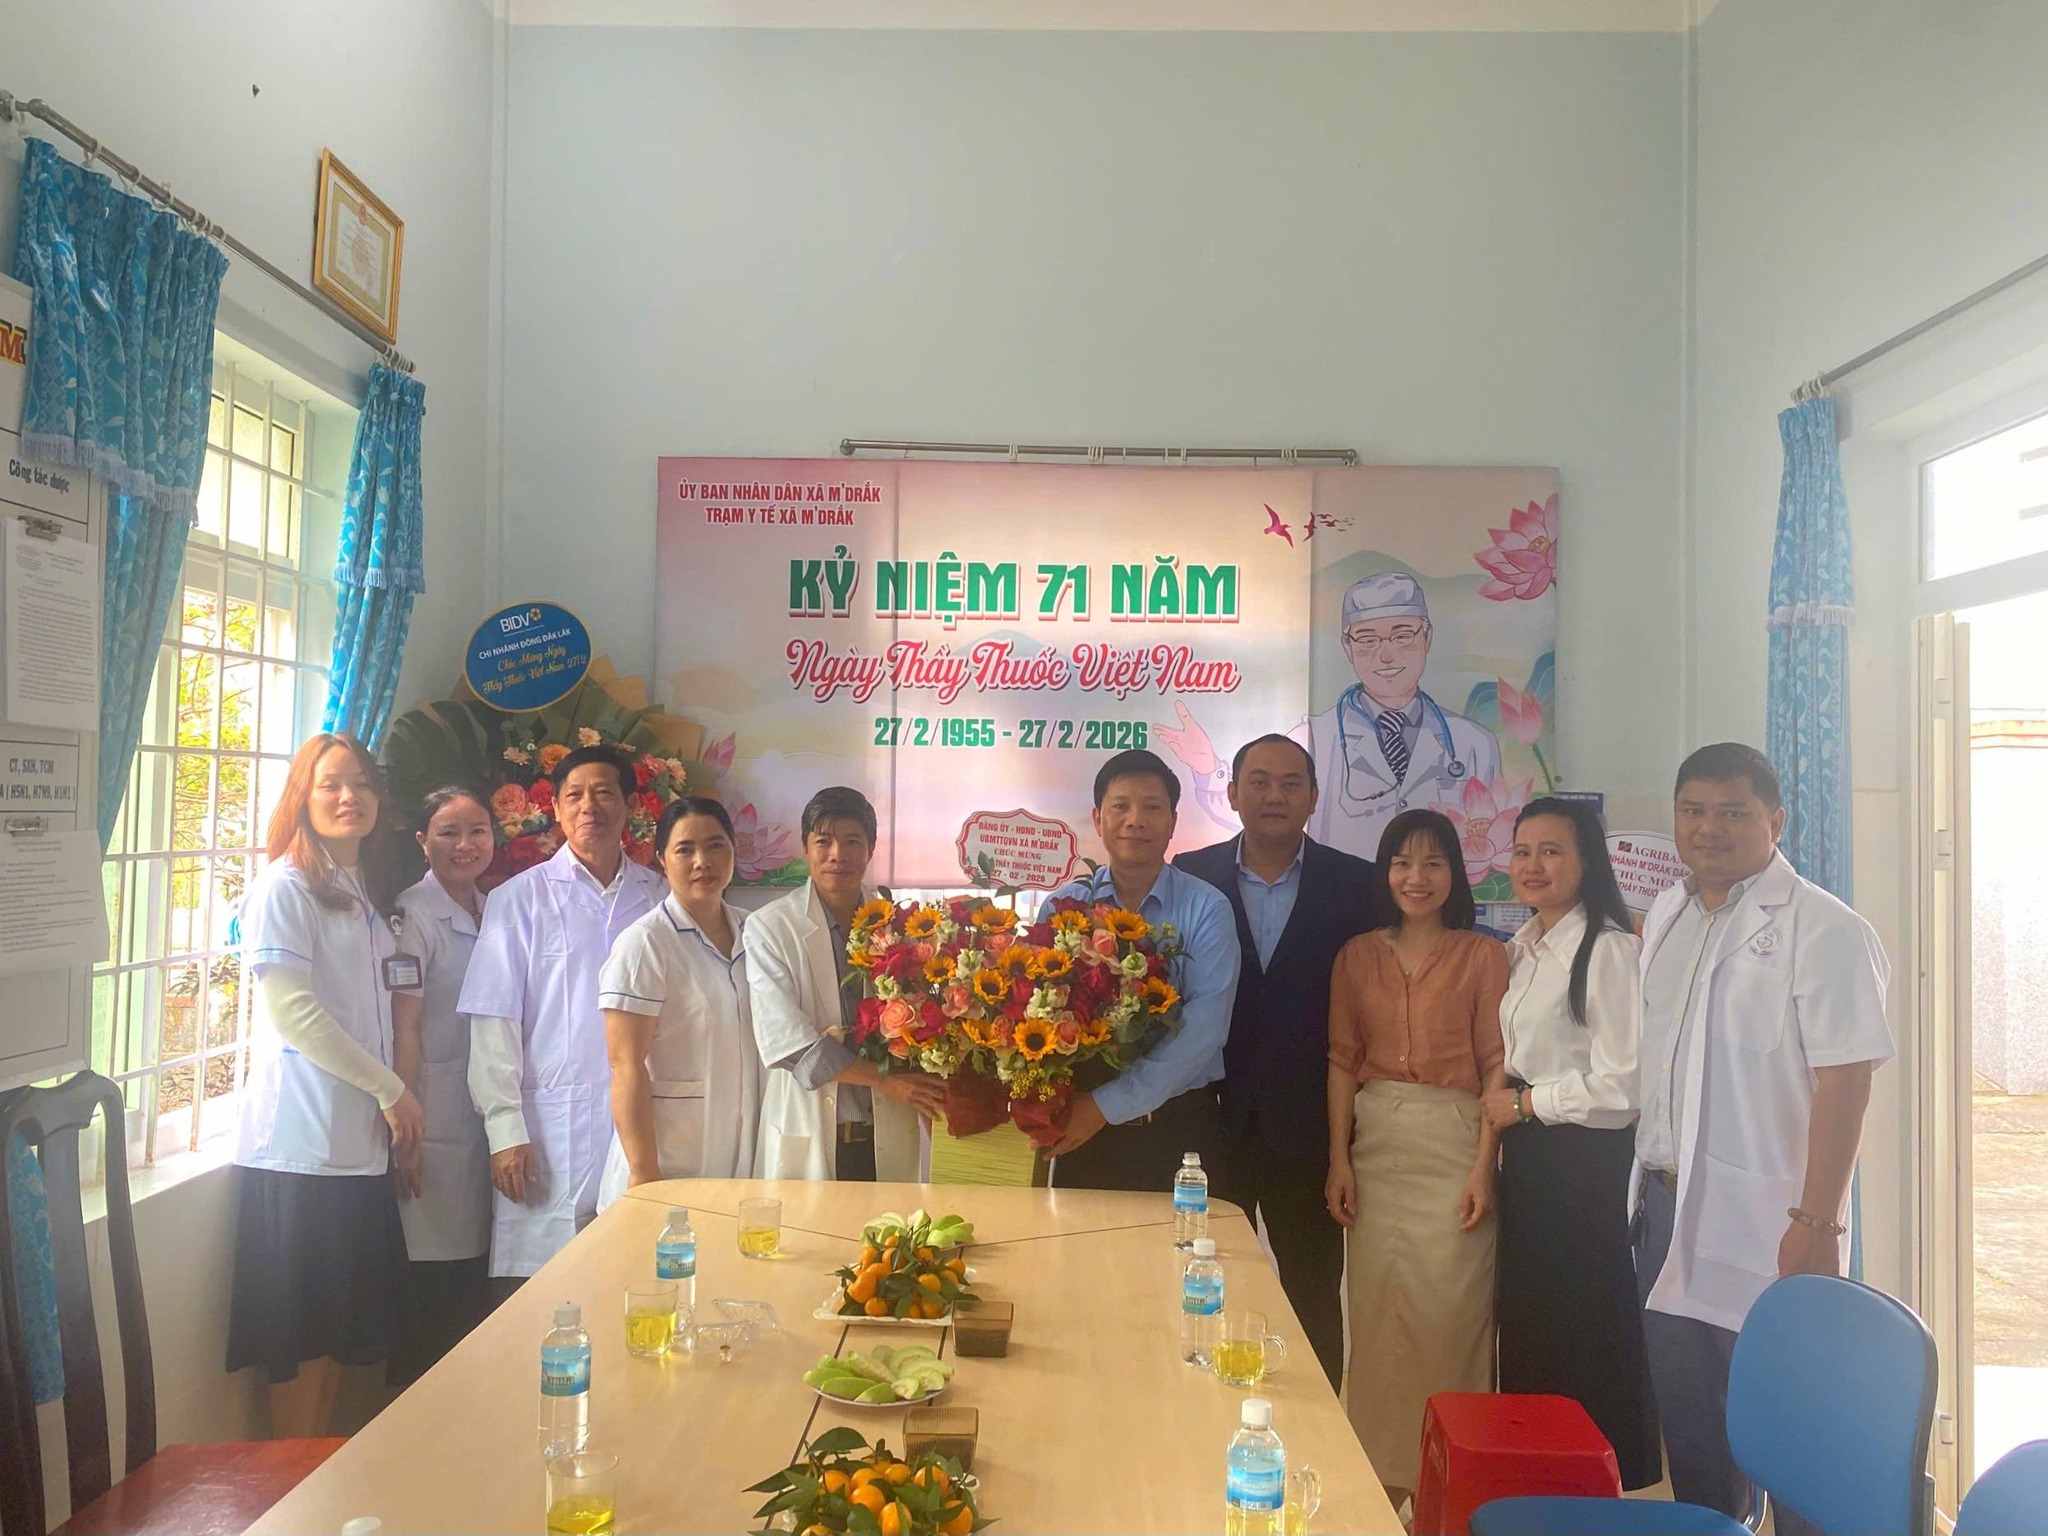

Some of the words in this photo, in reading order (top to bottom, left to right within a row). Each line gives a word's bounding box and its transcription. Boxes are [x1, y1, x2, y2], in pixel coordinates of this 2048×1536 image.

[10, 459, 32, 483] Công
[34, 467, 48, 487] tác
[679, 478, 697, 500] ỦY
[700, 484, 728, 500] BAN
[733, 482, 771, 501] NHÂN
[775, 482, 802, 502] DÂN
[806, 483, 825, 502] XÃ
[706, 508, 744, 526] TRẠM
[748, 508, 757, 524] Y
[760, 504, 776, 524] TẾ
[780, 506, 798, 525] XÃ
[789, 545, 857, 614] KỶ
[875, 551, 1018, 626] NIỆM
[1037, 564, 1088, 616] 71
[1110, 555, 1237, 618] NĂM
[500, 612, 531, 632] BIDV
[479, 649, 492, 660] CHI
[786, 639, 881, 700] Ngày
[886, 640, 966, 701] Thầy
[972, 640, 1068, 689] Thuốc
[1072, 643, 1148, 697] Việt
[1150, 644, 1238, 690] Nam
[873, 717, 996, 747] 27/2/1955
[1018, 719, 1148, 750] 27/2/2026
[980, 834, 1017, 846] UBMTTQVN
[1042, 829, 1062, 839] UBND
[1632, 846, 1677, 862] AGRIBA
[1009, 871, 1019, 879] 02
[1026, 874, 1046, 883] 2026
[1047, 866, 1062, 874] NAM
[1638, 886, 1659, 898] THUỐ
